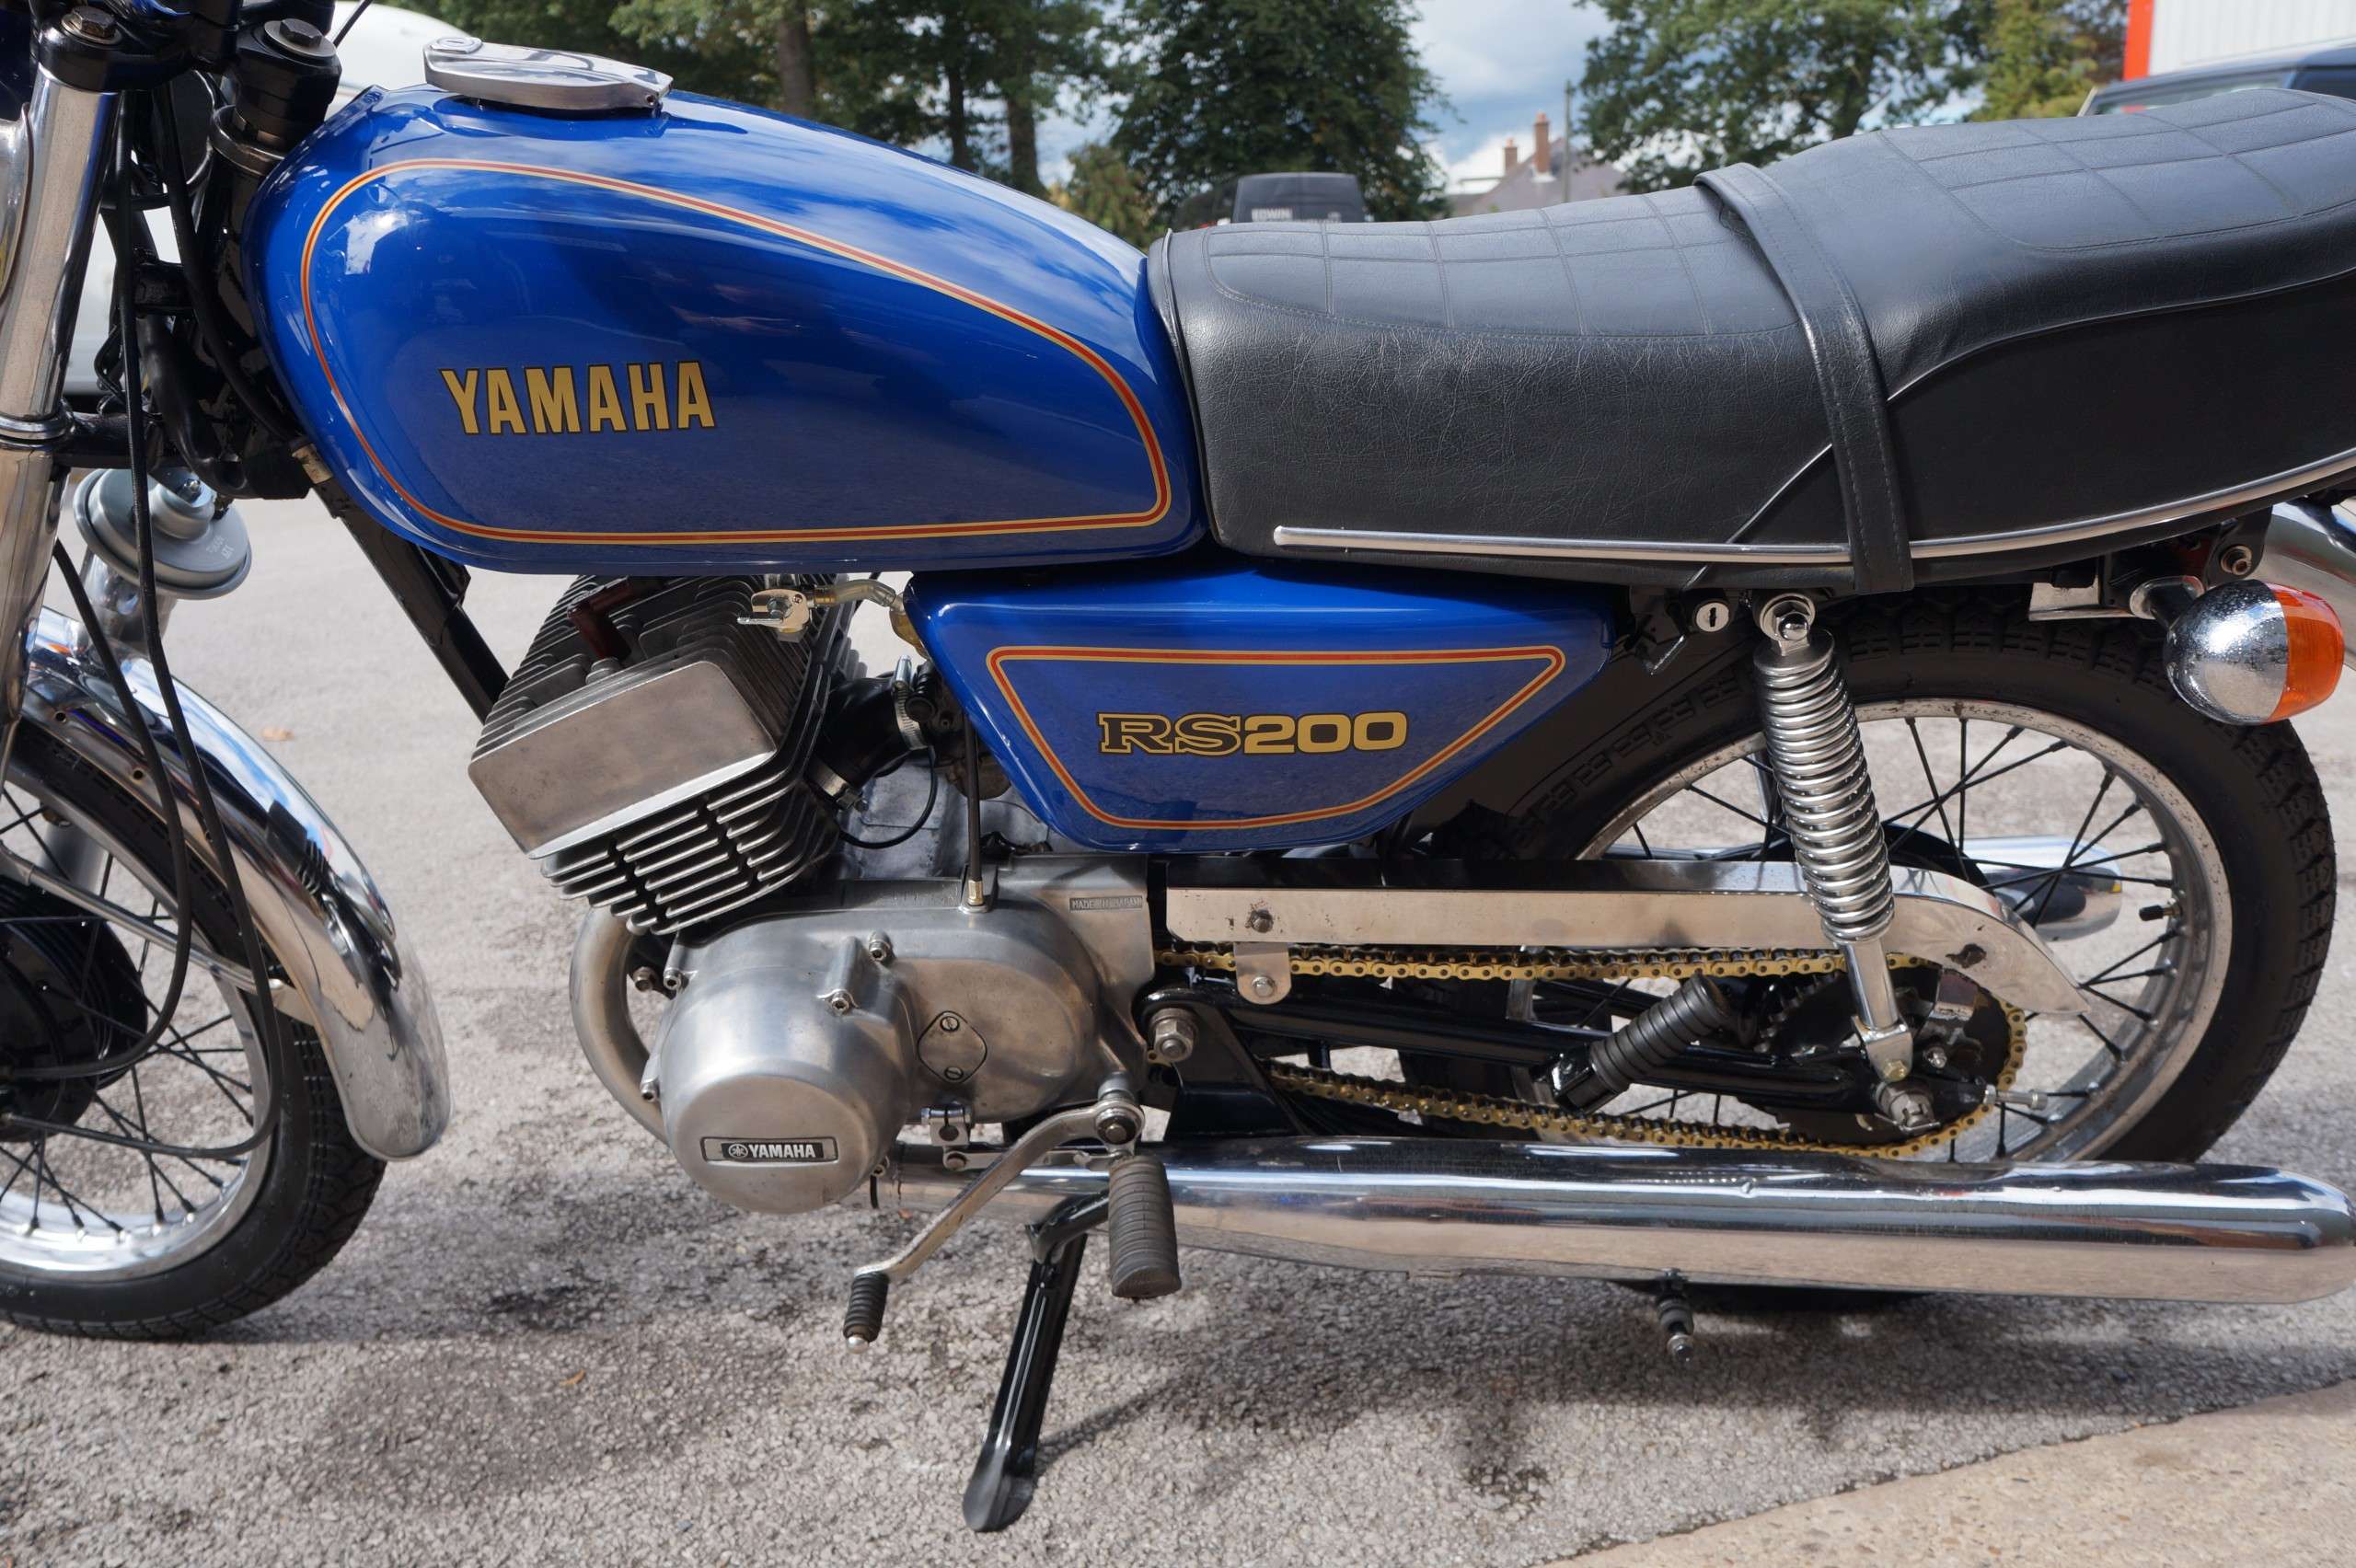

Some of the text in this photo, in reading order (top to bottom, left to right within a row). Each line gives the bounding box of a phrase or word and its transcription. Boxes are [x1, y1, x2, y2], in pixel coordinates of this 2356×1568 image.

[440, 360, 715, 435] YAMAHA
[1097, 711, 1407, 756] RS200
[1072, 898, 1097, 909] MADE
[747, 1144, 816, 1159] YAMAHA
